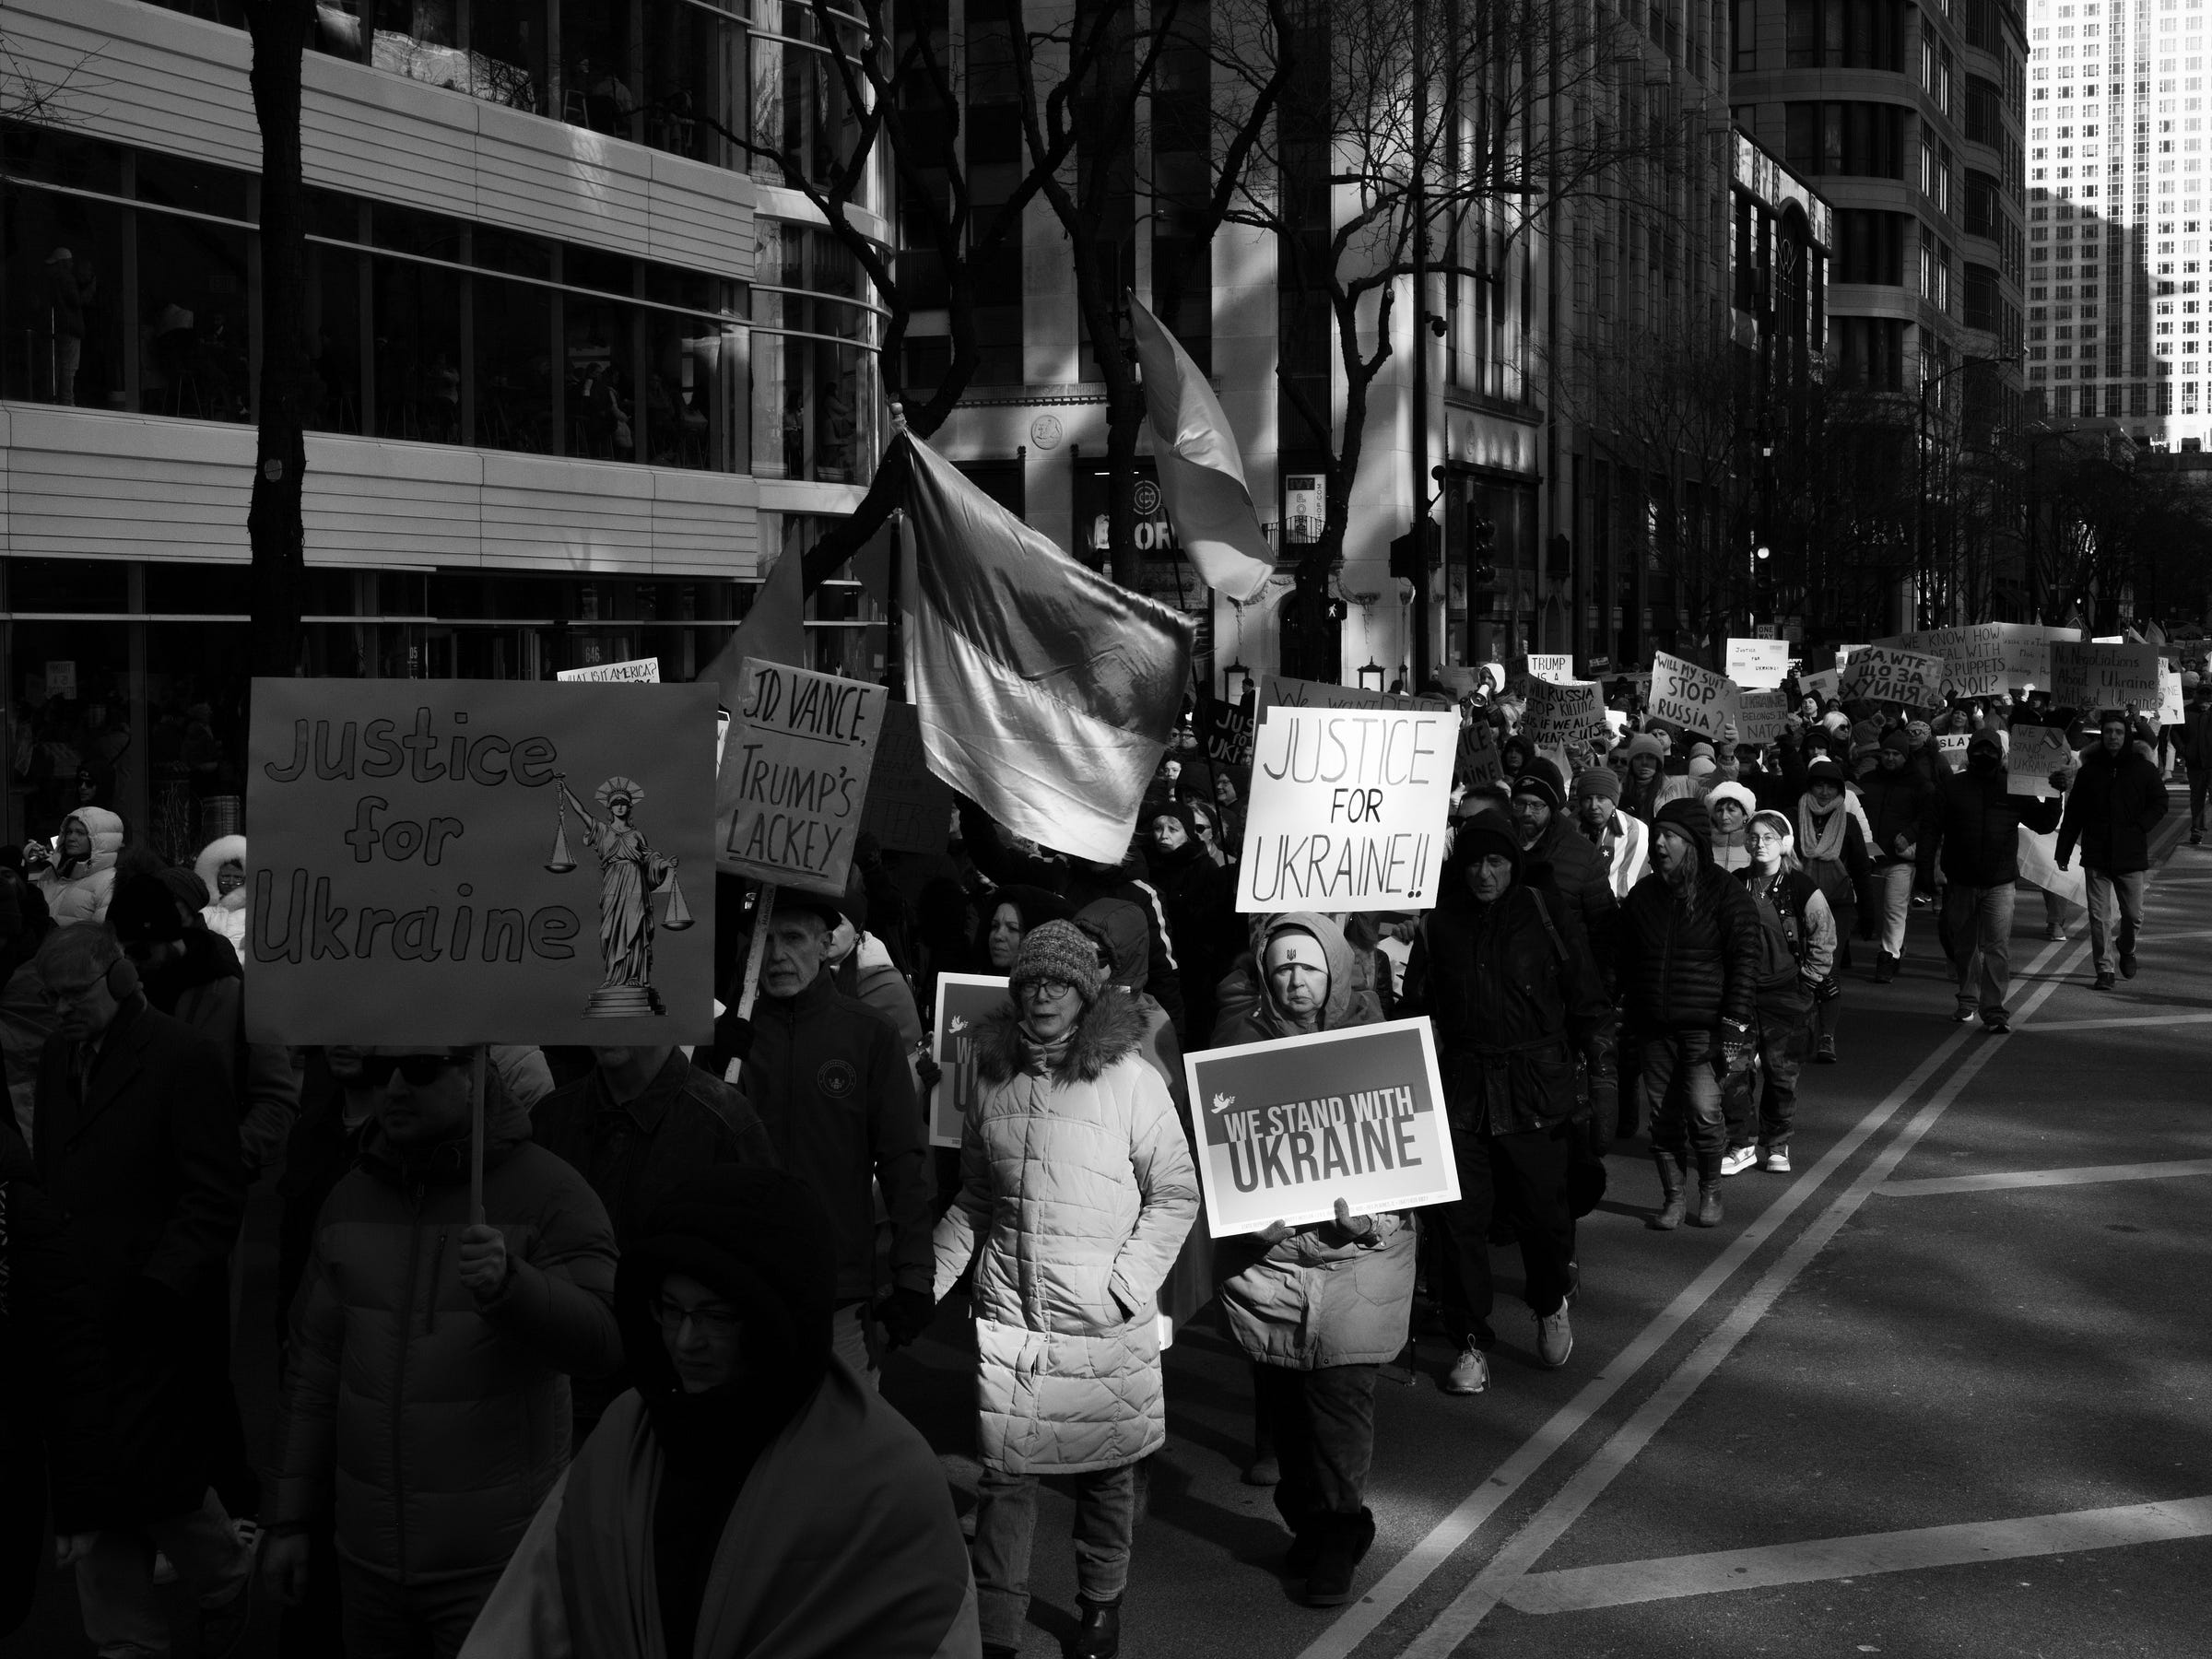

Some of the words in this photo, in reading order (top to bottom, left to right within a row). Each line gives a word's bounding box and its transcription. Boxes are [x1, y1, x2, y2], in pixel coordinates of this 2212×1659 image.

[1901, 636, 1920, 650] WE
[1928, 630, 1966, 647] KNOW
[1973, 627, 2000, 642] HOW
[1965, 642, 2000, 657] WITH
[1532, 657, 1566, 670] TRUMP
[2055, 646, 2068, 664] No
[2072, 647, 2140, 668] Negotiations
[610, 662, 658, 680] AMERICA?
[1658, 655, 1677, 672] WILL
[1681, 663, 1697, 679] MY
[1700, 673, 1726, 689] SUIT
[1897, 668, 1924, 685] ЗА
[2058, 668, 2088, 687] About
[2101, 670, 2155, 689] Ukraine
[1548, 687, 1594, 701] RUSSIA
[1668, 677, 1716, 705] STOP
[1739, 694, 1786, 709] UKRAINE
[789, 674, 871, 747] VANCE,
[1742, 712, 1775, 722] BELONGS
[1777, 711, 1788, 720] IN
[1554, 719, 1571, 729] WE
[1747, 724, 1780, 739] NATO
[2018, 727, 2035, 738] WE
[265, 707, 557, 787] Justice
[1263, 717, 1437, 785] JUSTICE
[1463, 725, 1488, 756] ICE
[1939, 737, 1971, 747] SLA
[2013, 743, 2041, 754] STAND
[2013, 760, 2057, 773] UKRAINE
[740, 745, 857, 818] TRUMP'S
[1330, 788, 1383, 823] FOR
[345, 795, 464, 866] for
[726, 809, 842, 871] LACKEY
[1253, 832, 1430, 901] UKRAINE!!
[253, 868, 581, 964] Ukraine
[1223, 1109, 1264, 1143] WE
[1266, 1097, 1346, 1136] STAND
[1349, 1086, 1414, 1124] WITH
[1228, 1113, 1423, 1194] UKRAINE
